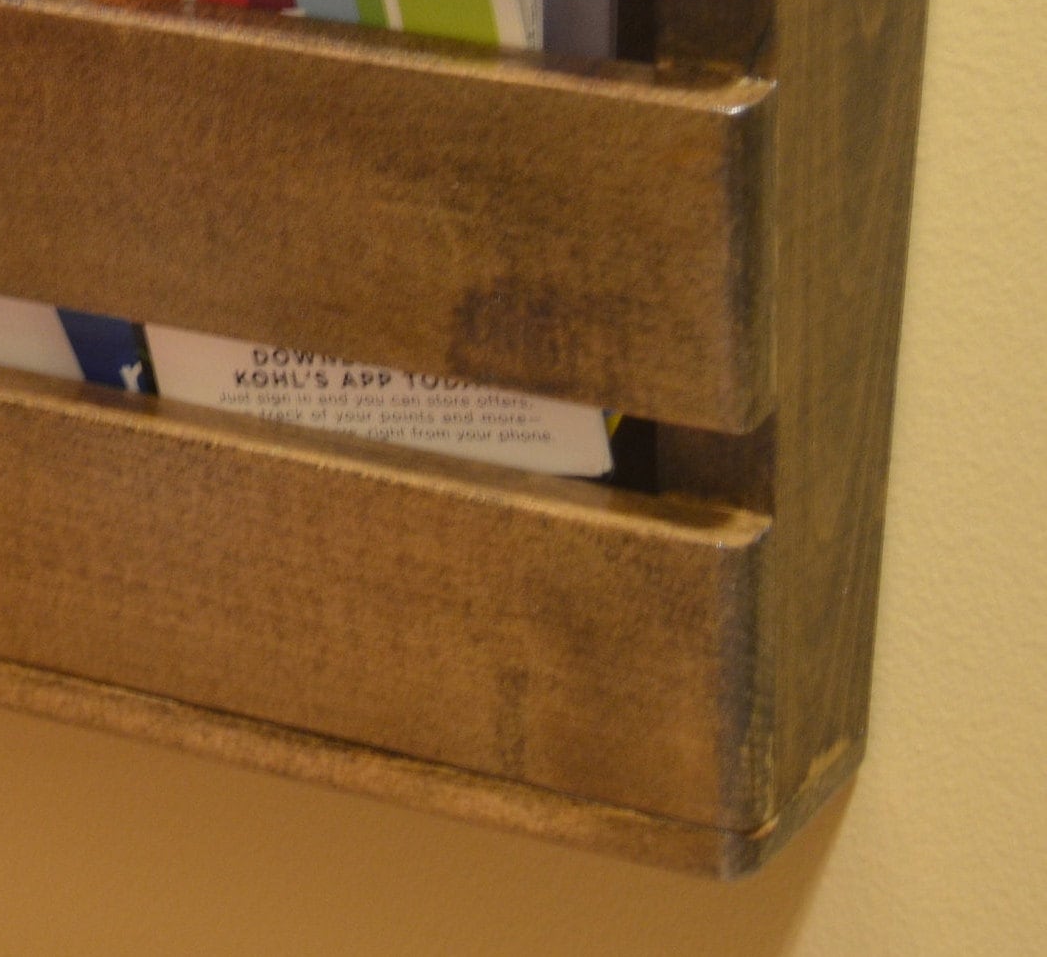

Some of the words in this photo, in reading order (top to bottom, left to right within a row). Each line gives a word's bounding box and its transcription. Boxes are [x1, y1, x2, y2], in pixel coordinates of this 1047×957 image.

[235, 369, 328, 388] KOHL'S
[343, 371, 392, 389] APP
[258, 393, 292, 406] sign
[319, 394, 348, 405] and
[357, 396, 384, 408] you
[392, 396, 420, 406] can
[428, 395, 470, 407] store
[312, 407, 328, 419] of
[337, 411, 372, 423] your
[381, 411, 434, 423] points
[443, 412, 473, 423] and
[411, 427, 451, 439] from
[457, 430, 492, 442] your
